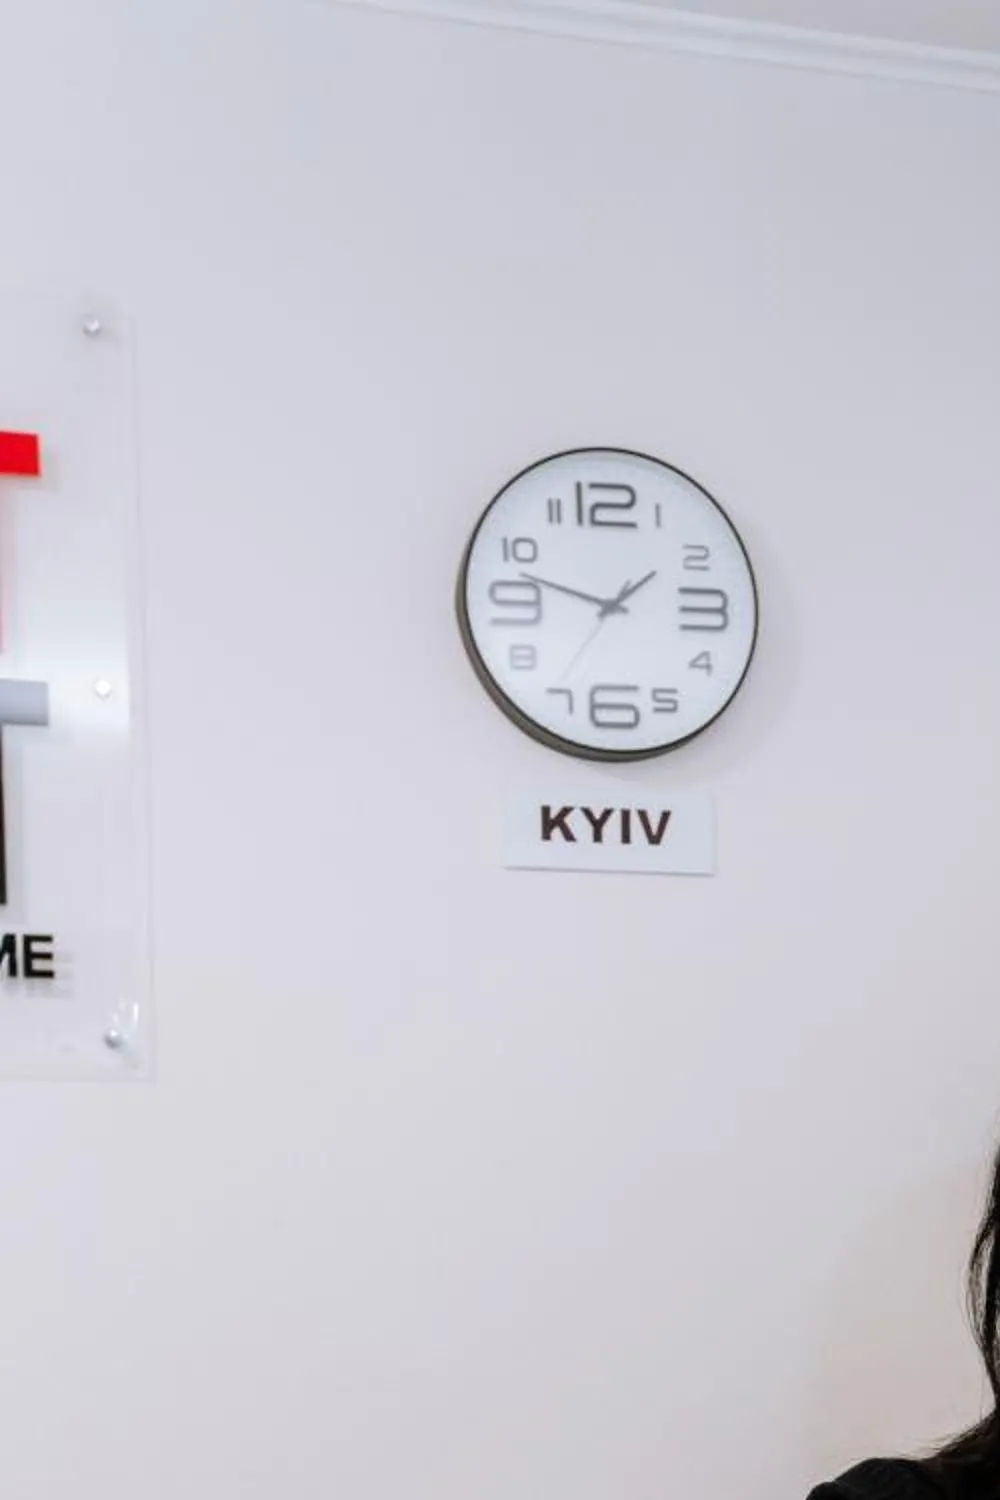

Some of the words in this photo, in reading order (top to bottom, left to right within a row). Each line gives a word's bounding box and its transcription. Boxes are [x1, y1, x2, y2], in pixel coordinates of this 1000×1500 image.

[574, 480, 639, 530] 12
[655, 503, 661, 529] 1
[501, 536, 539, 564] 10
[682, 544, 711, 572] 2
[488, 578, 543, 628] 9
[677, 585, 730, 633] 3
[509, 643, 538, 671] 8
[688, 649, 713, 676] 4
[546, 687, 575, 716] 7
[588, 684, 641, 731] 6
[651, 687, 680, 714] 5
[539, 804, 673, 847] KYIV
